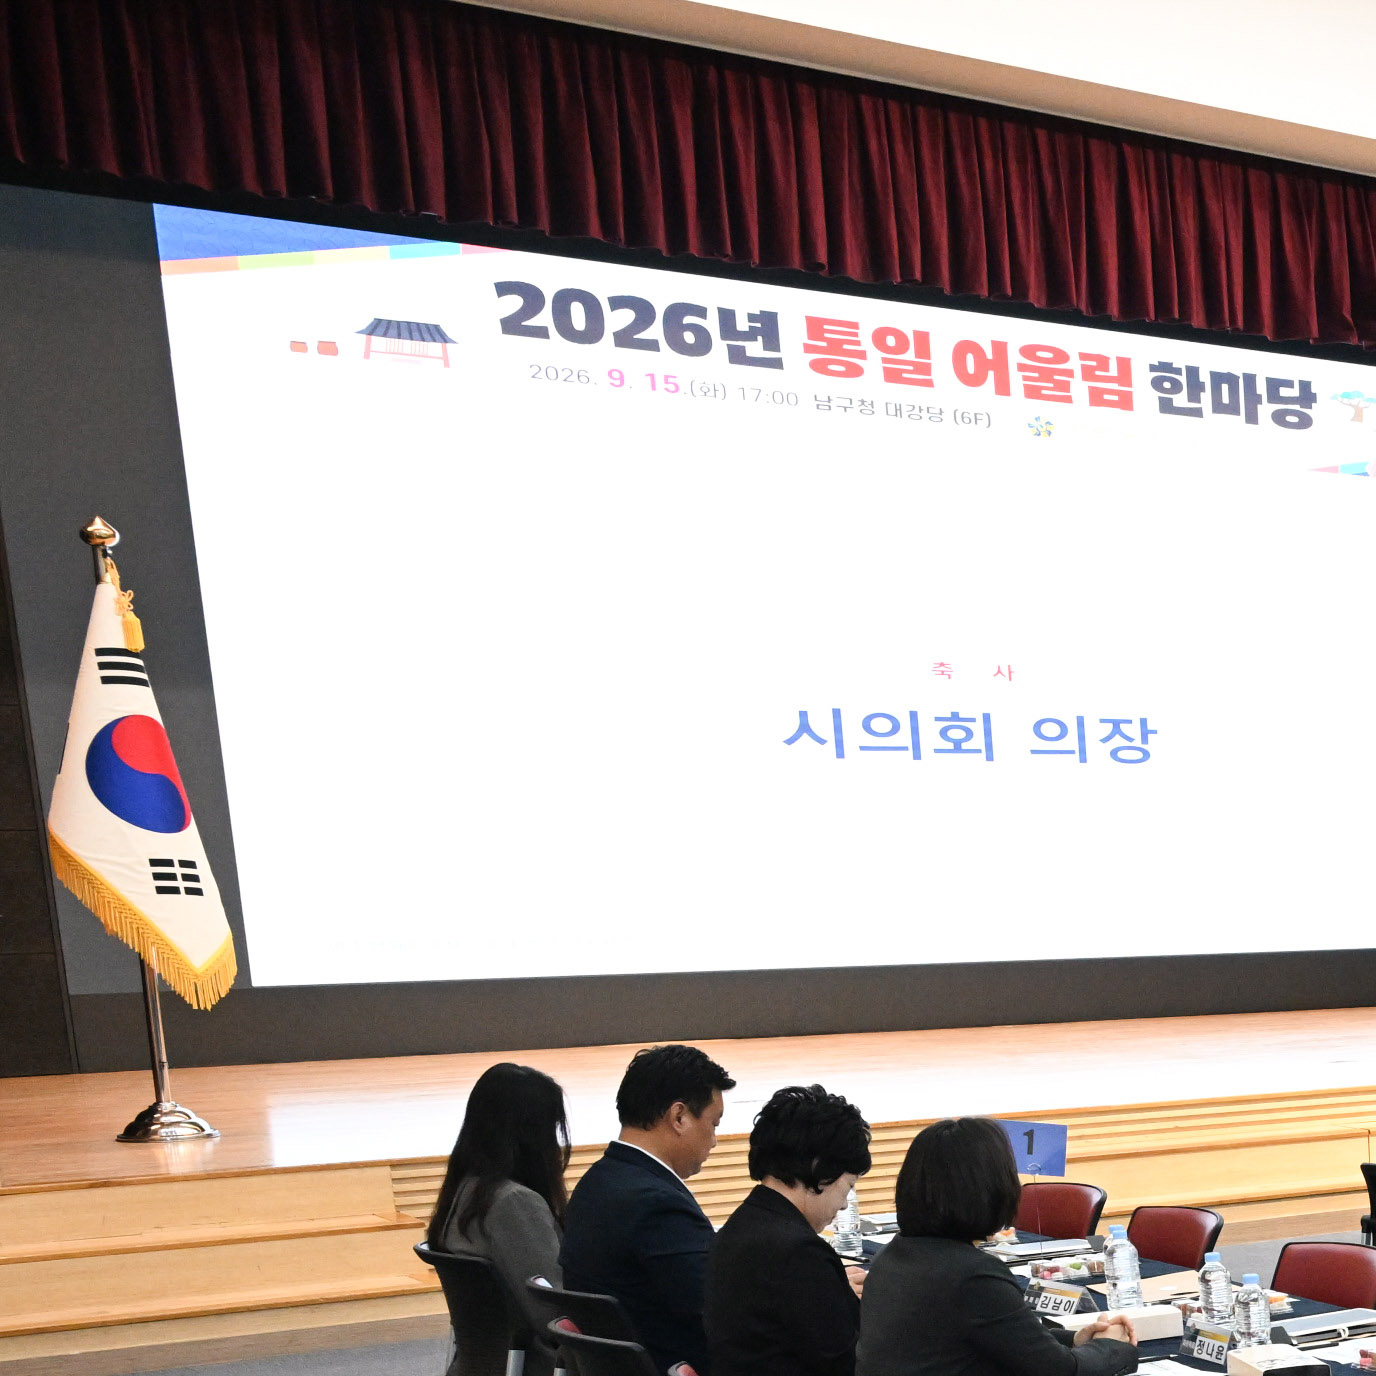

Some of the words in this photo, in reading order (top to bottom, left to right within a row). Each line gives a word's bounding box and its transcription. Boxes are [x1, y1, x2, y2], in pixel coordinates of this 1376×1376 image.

[494, 280, 785, 371] 2026년
[803, 315, 935, 388] 통일
[951, 339, 1134, 412] 어울림
[1148, 360, 1318, 431] 한마당
[529, 363, 598, 385] 2026.
[737, 386, 799, 407] 17:00
[813, 393, 875, 417] 남구청
[884, 400, 945, 424] 대강당
[953, 407, 992, 429] (6F)
[782, 707, 995, 762] 시의회
[1029, 715, 1158, 764] 의장
[1023, 1128, 1035, 1156] 1
